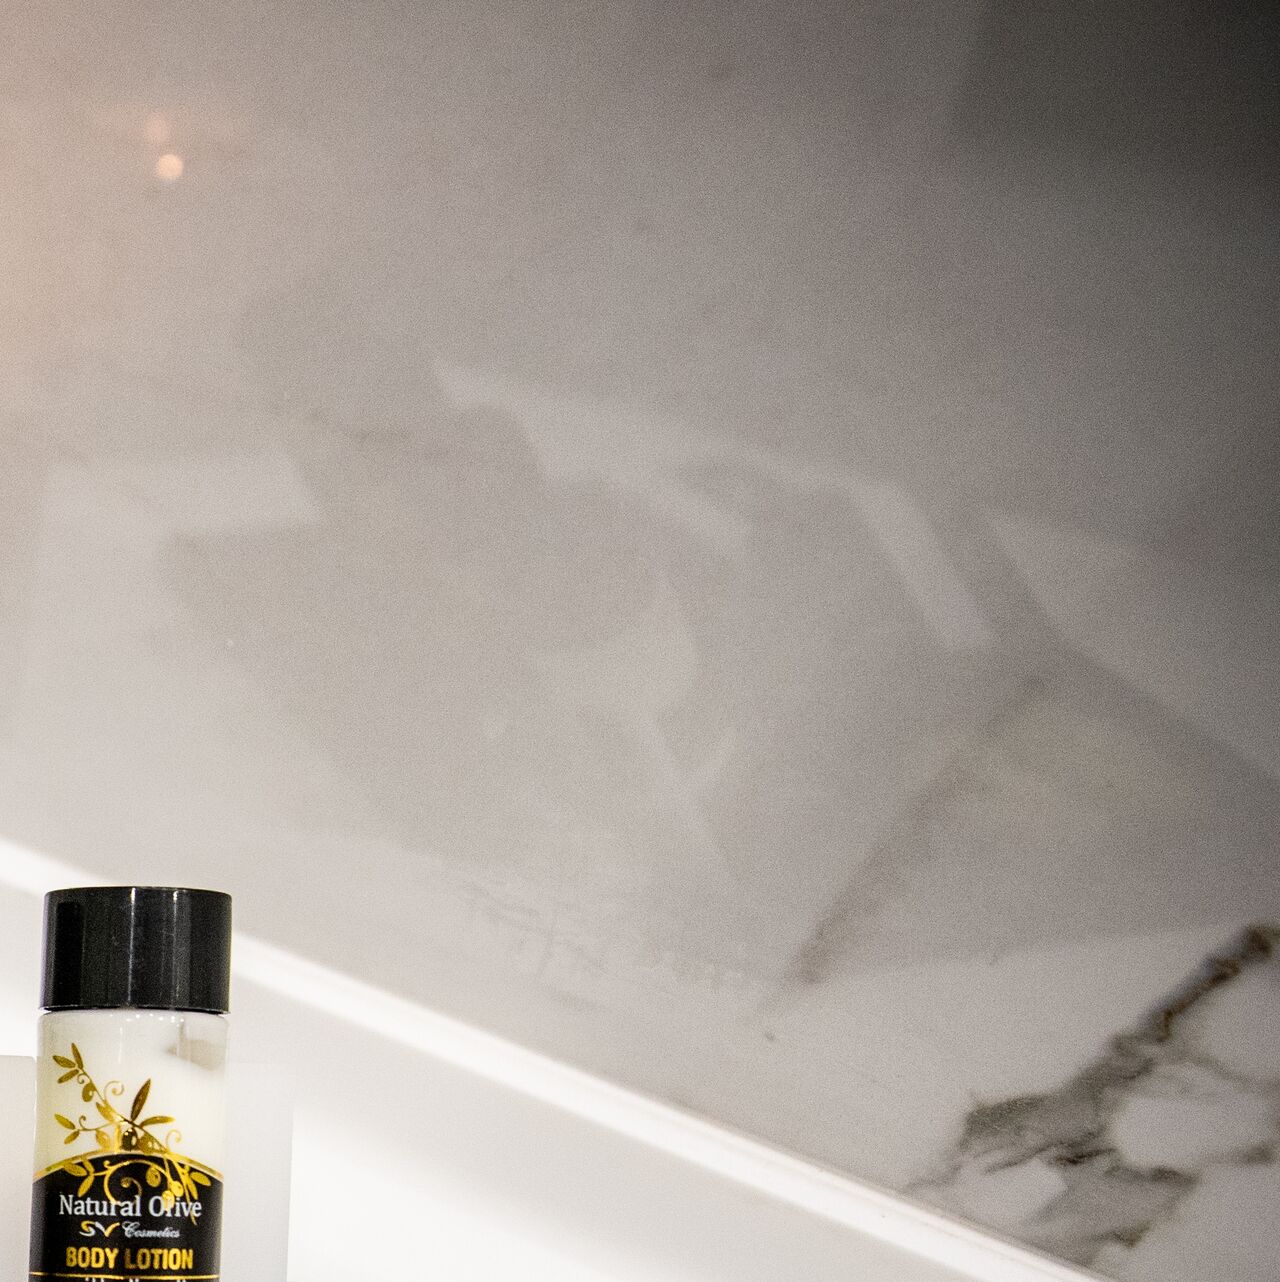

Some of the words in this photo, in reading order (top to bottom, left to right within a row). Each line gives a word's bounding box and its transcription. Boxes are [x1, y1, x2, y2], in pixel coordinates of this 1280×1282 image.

[59, 1193, 141, 1218] Natural
[148, 1196, 202, 1219] Olive
[121, 1221, 180, 1239] Cosmetics
[65, 1246, 118, 1269] BODY
[124, 1247, 193, 1271] LOTION
